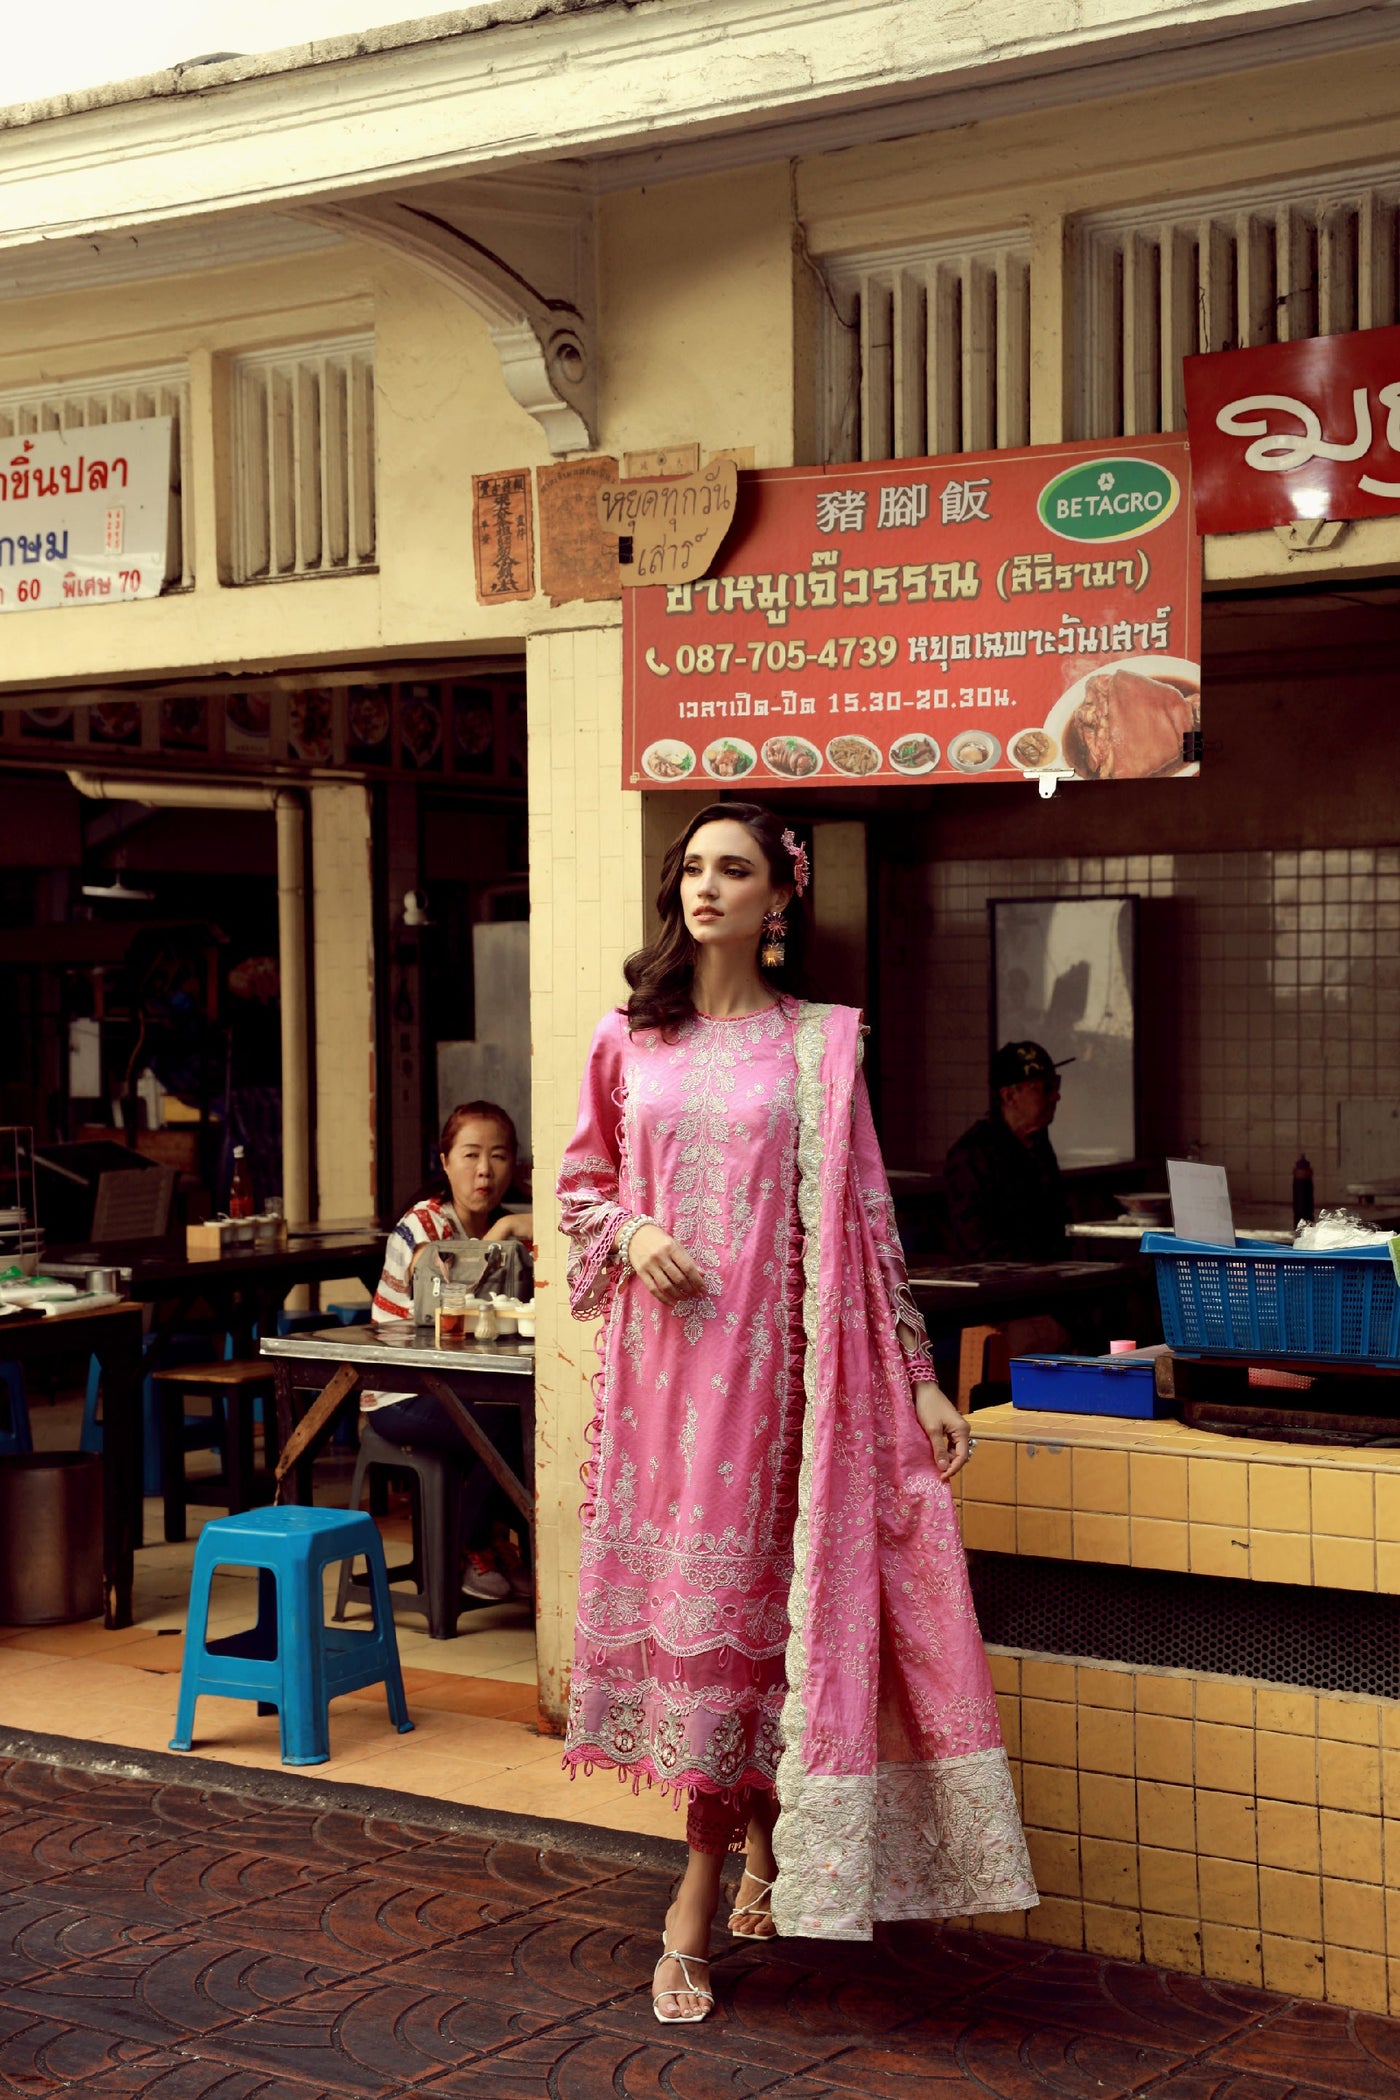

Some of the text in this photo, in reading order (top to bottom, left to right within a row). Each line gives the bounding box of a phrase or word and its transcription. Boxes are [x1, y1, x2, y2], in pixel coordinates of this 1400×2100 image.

[602, 466, 731, 534] หยุดทุกวัน
[816, 478, 990, 532] 豬腳飯
[1056, 491, 1162, 520] BETAGRO
[18, 579, 41, 602] 60
[62, 571, 111, 598] พิเศษ
[119, 570, 141, 592] 70
[676, 606, 1171, 674] 087-705-4739 หยุดเฉพาะวันเสาร์
[679, 687, 1017, 719] เวลาเปิด-ปิด 15.30-20.30น.
